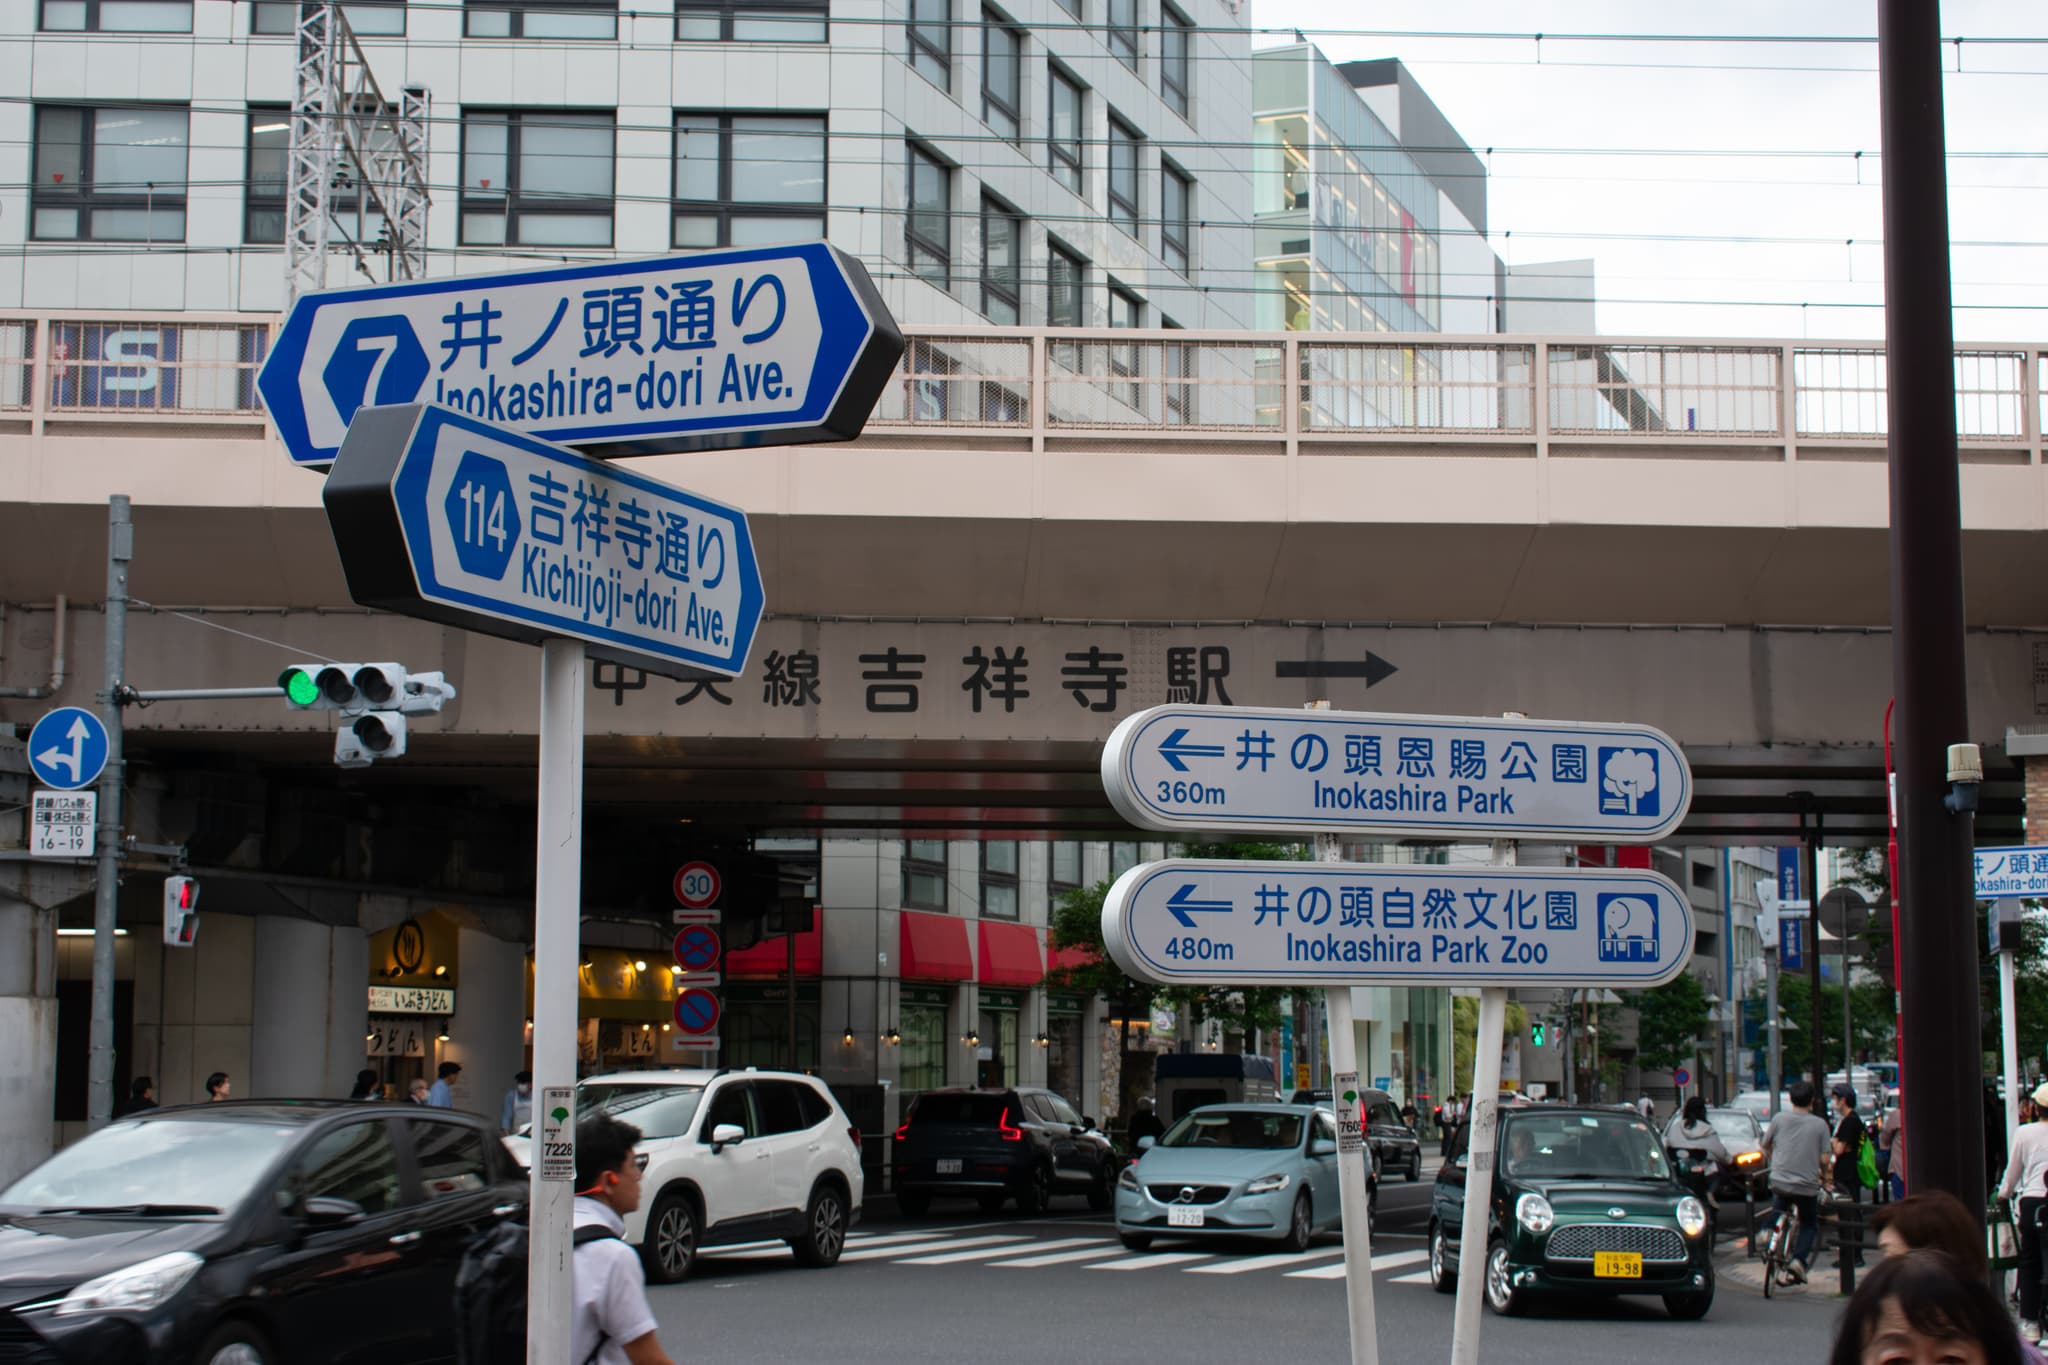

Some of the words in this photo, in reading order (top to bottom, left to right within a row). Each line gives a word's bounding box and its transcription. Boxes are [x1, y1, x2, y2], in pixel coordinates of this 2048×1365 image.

[440, 273, 787, 372] 井ノ頭通り
[356, 334, 398, 407] 7
[436, 355, 702, 421] Inokashira-dori
[718, 353, 793, 404] Ave.
[460, 479, 507, 553] 114
[528, 470, 725, 590] 吉祥寺通り
[522, 542, 677, 634] Kichijoji-dori
[685, 591, 729, 647] Ave.
[1236, 729, 1588, 784] 井の頭恩賜公園
[1157, 780, 1226, 805] 360m
[1314, 779, 1447, 813] Inokashira
[1457, 785, 1515, 815] Park
[684, 874, 711, 896] 30
[1254, 884, 1577, 931] 井の頭自然文化園
[1165, 936, 1234, 960] 480m
[1287, 933, 1421, 963] Inokashira
[1432, 935, 1490, 964] Park
[1501, 936, 1548, 964] Zoo
[1340, 1121, 1362, 1133] 760
[544, 1143, 573, 1157] 7228
[1606, 1262, 1640, 1276] 19-98
